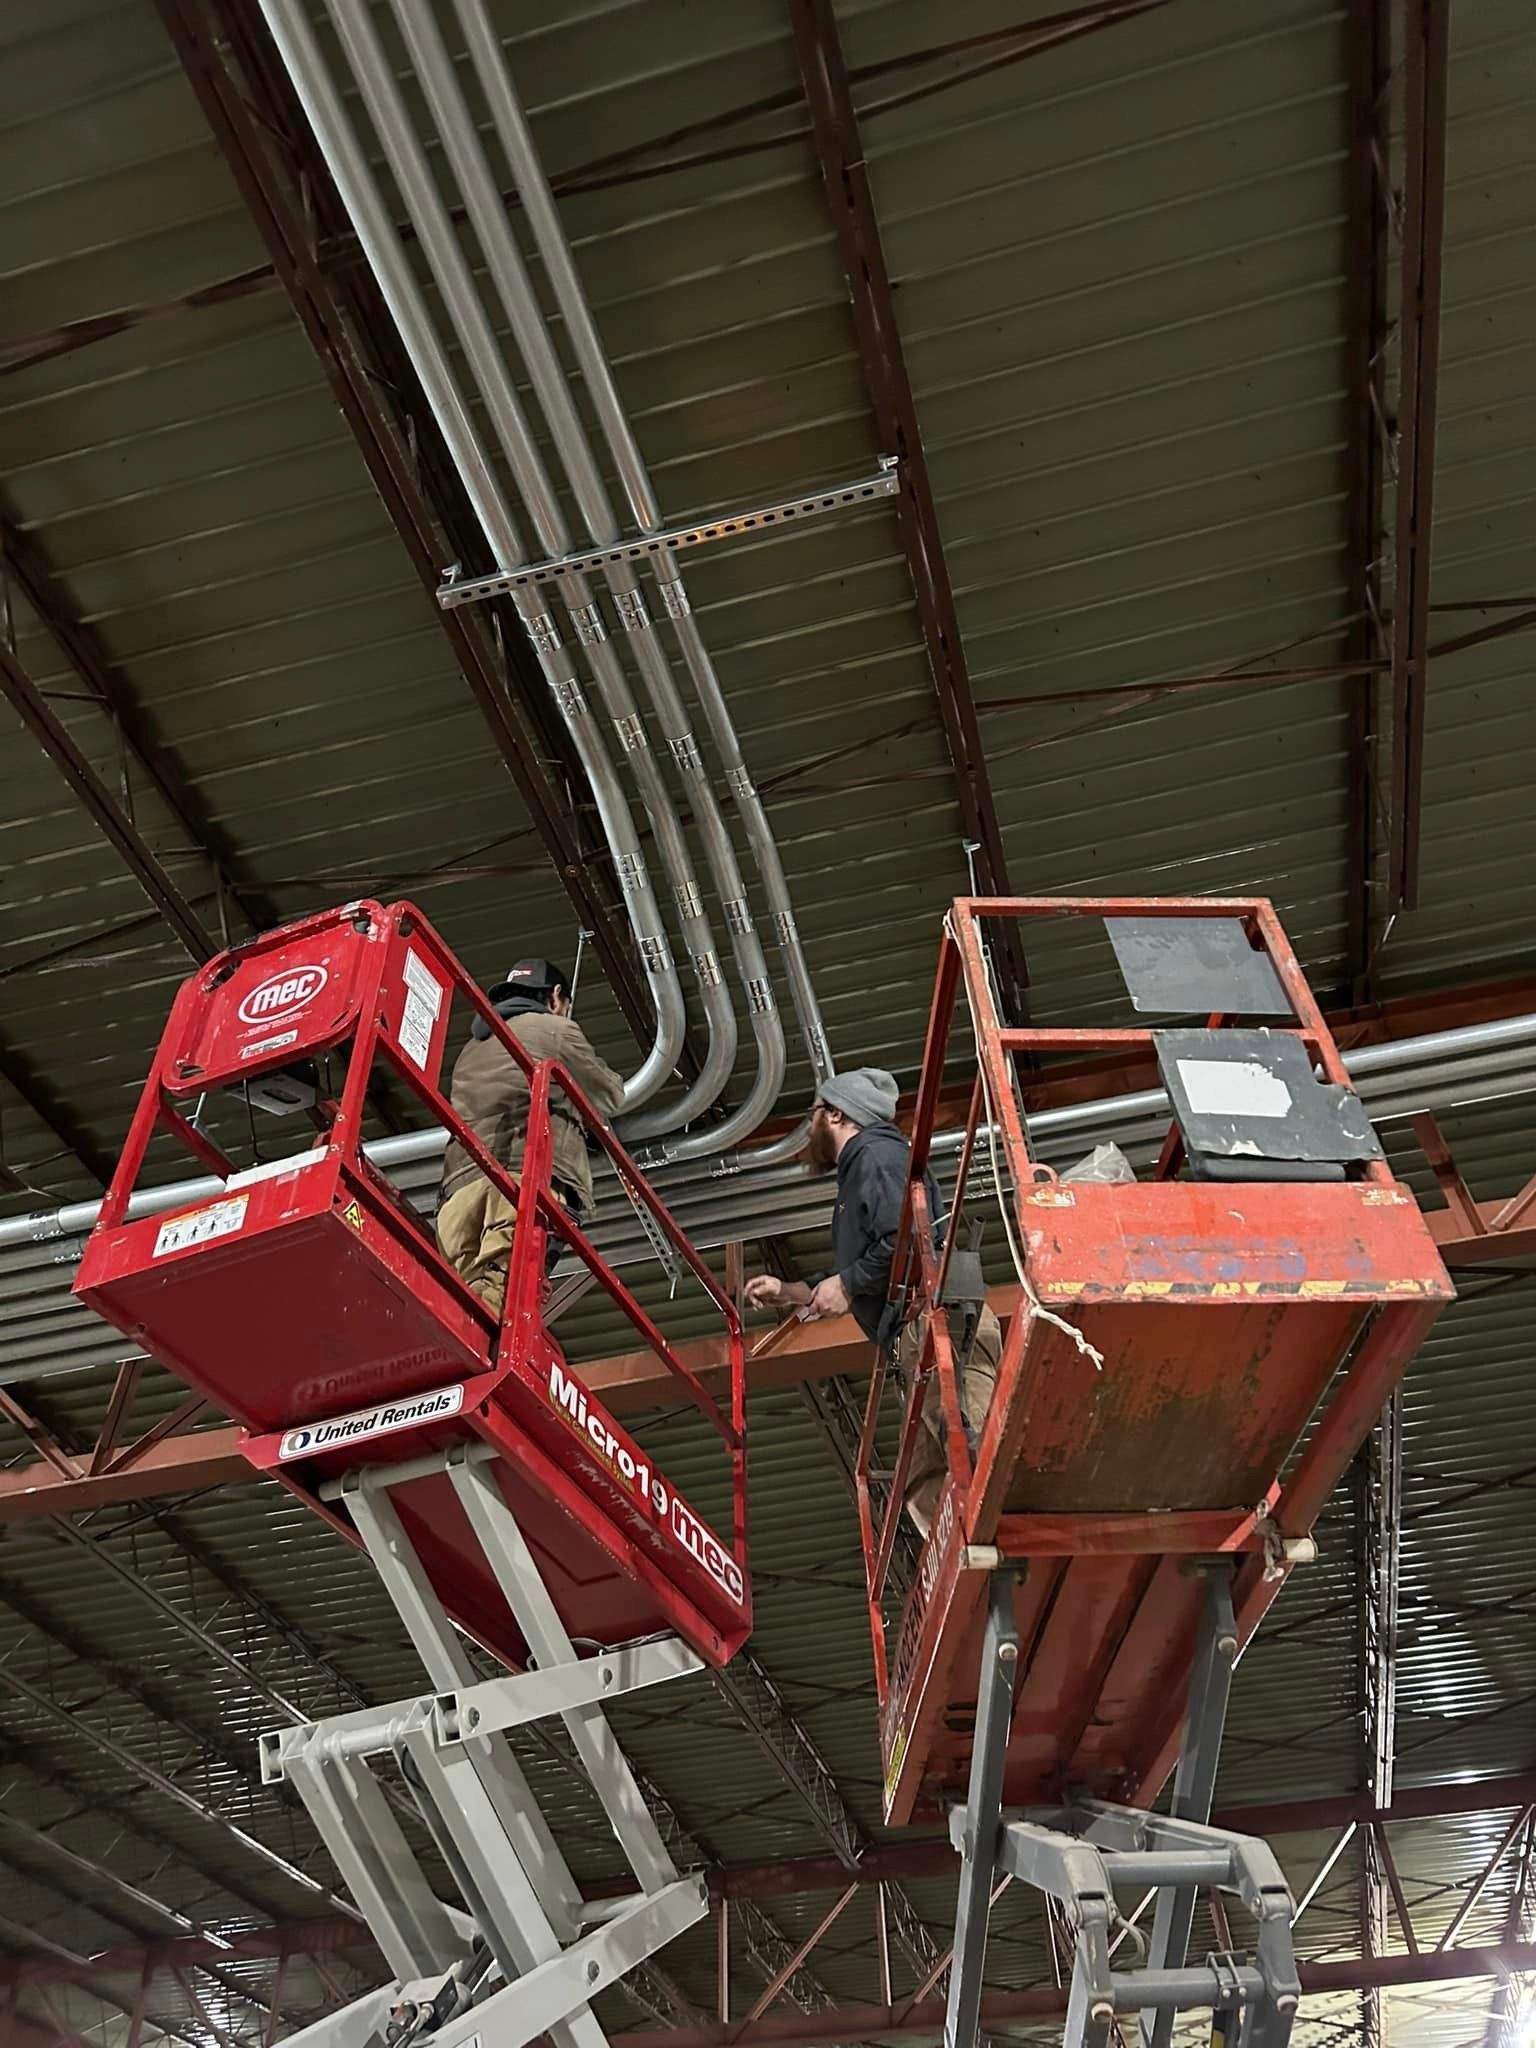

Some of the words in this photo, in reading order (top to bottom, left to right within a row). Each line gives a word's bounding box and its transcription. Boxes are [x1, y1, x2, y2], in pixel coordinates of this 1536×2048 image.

[315, 1412, 379, 1444] United
[380, 1395, 451, 1427] Rentals
[550, 1362, 668, 1516] Micro19
